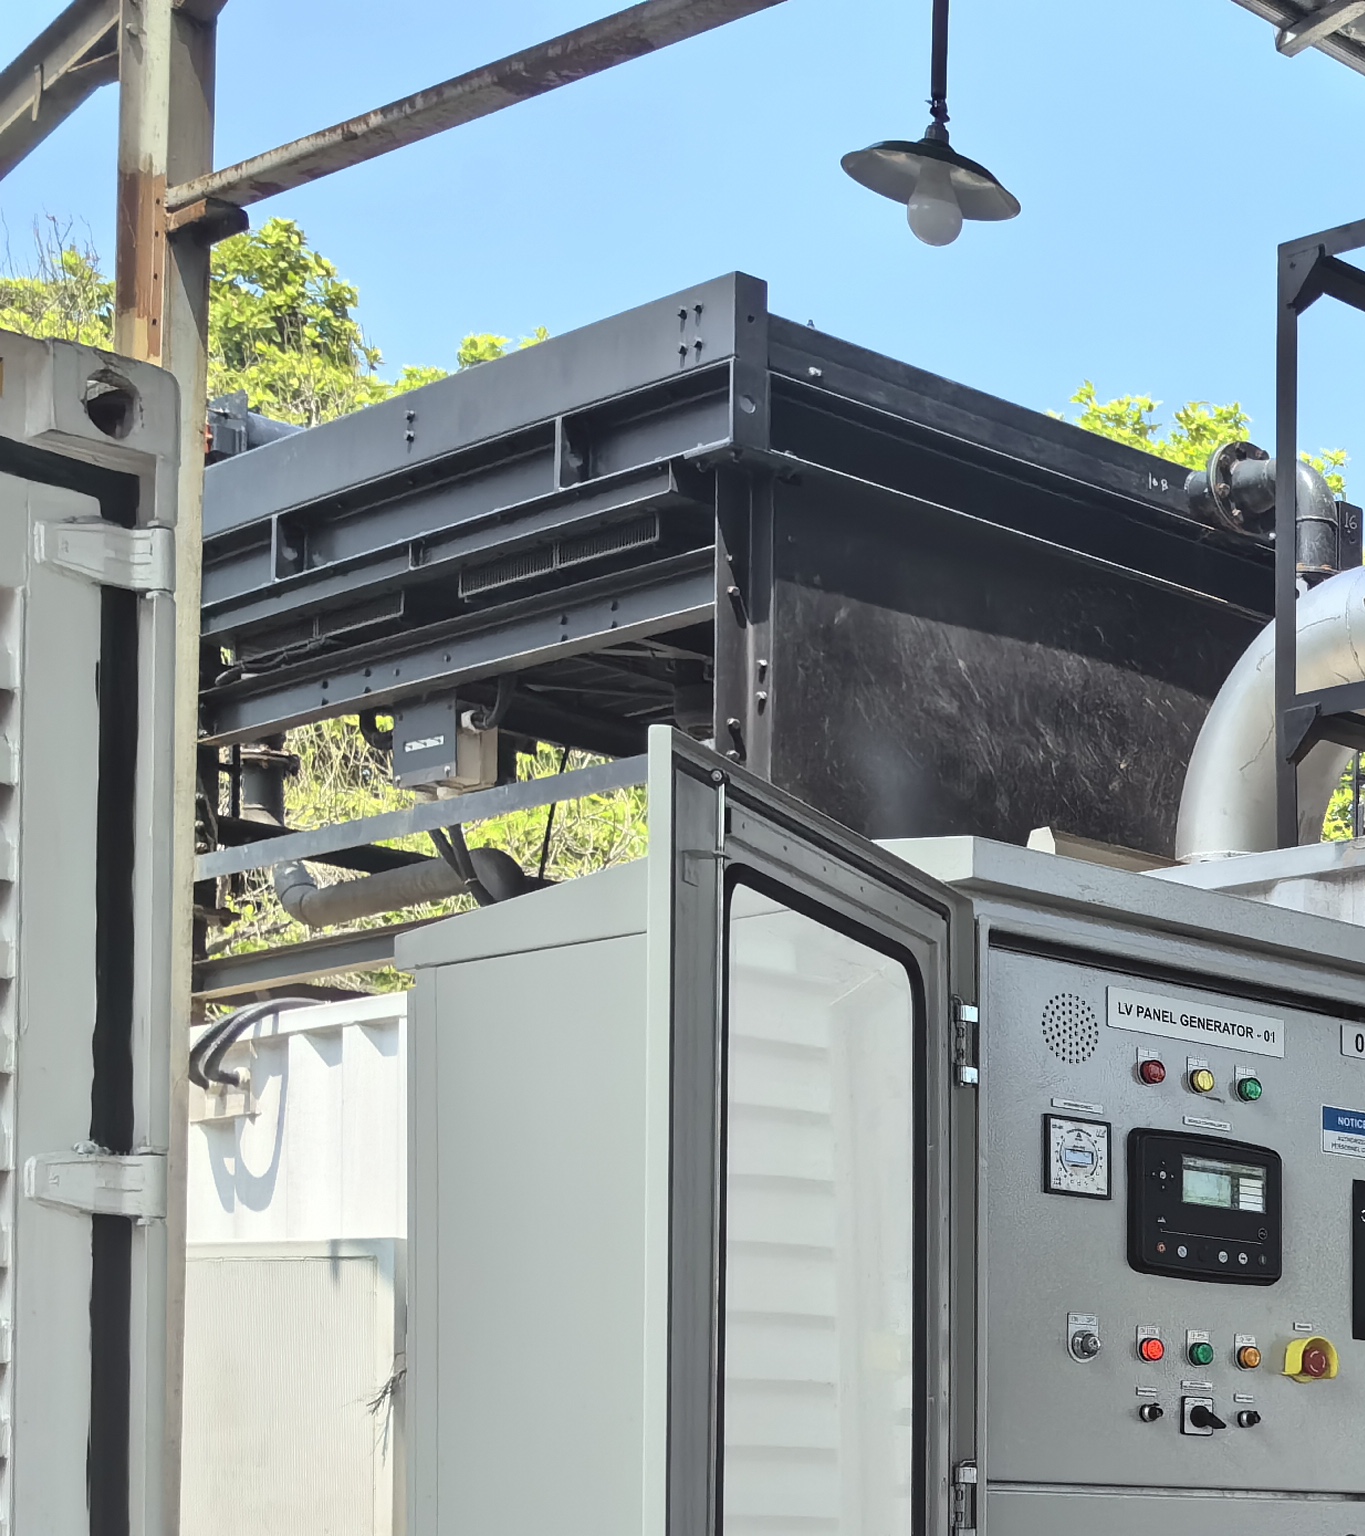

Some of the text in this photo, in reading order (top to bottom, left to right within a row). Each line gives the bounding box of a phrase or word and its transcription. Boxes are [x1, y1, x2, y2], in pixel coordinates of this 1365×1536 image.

[1118, 1002, 1133, 1015] LV
[1136, 1005, 1177, 1024] PANEL
[1180, 1014, 1254, 1039] GENERATOR
[1263, 1030, 1275, 1043] 01
